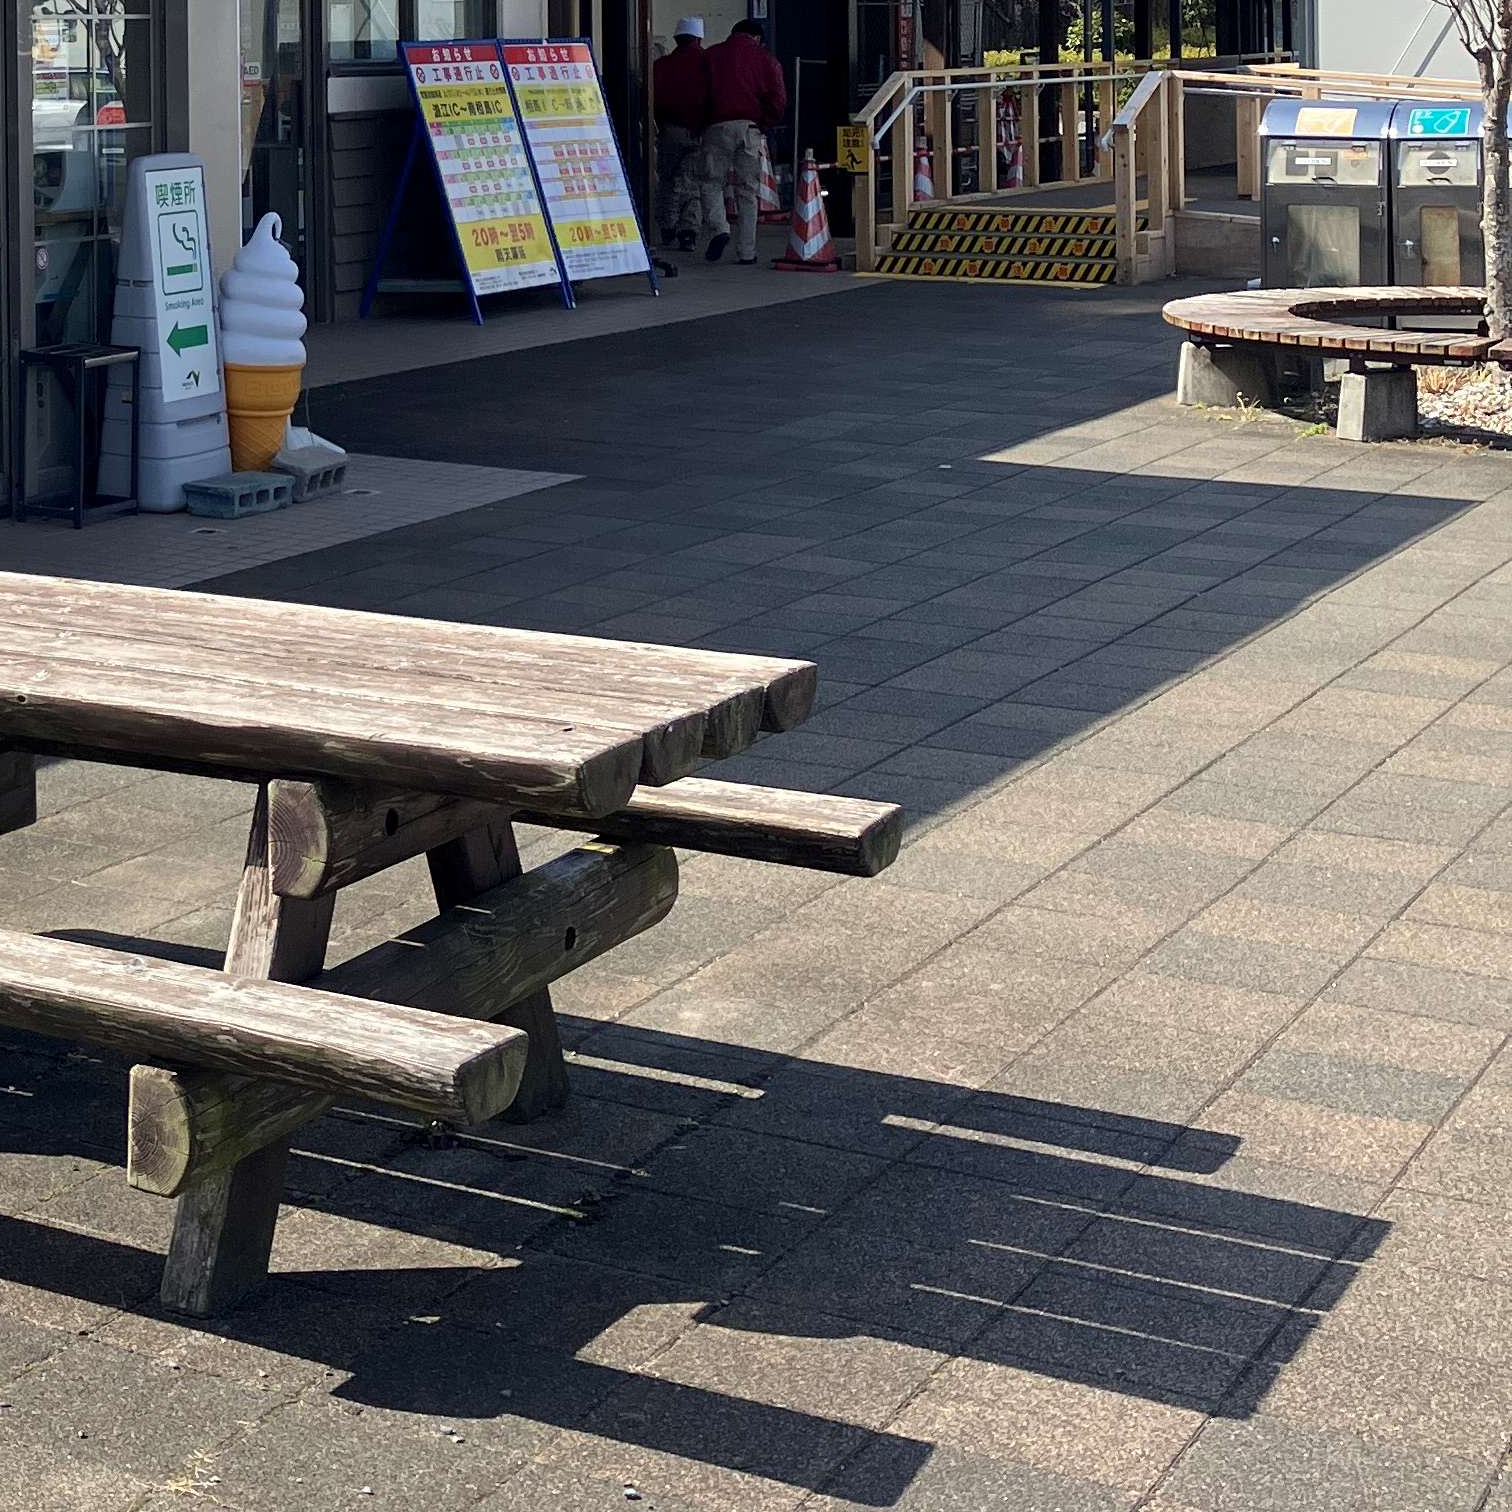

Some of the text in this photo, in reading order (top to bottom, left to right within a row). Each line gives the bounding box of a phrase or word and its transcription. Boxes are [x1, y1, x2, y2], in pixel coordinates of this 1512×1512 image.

[431, 46, 473, 63] お知らせ
[526, 46, 570, 63] お知らせ
[155, 179, 197, 210] 喫煙所
